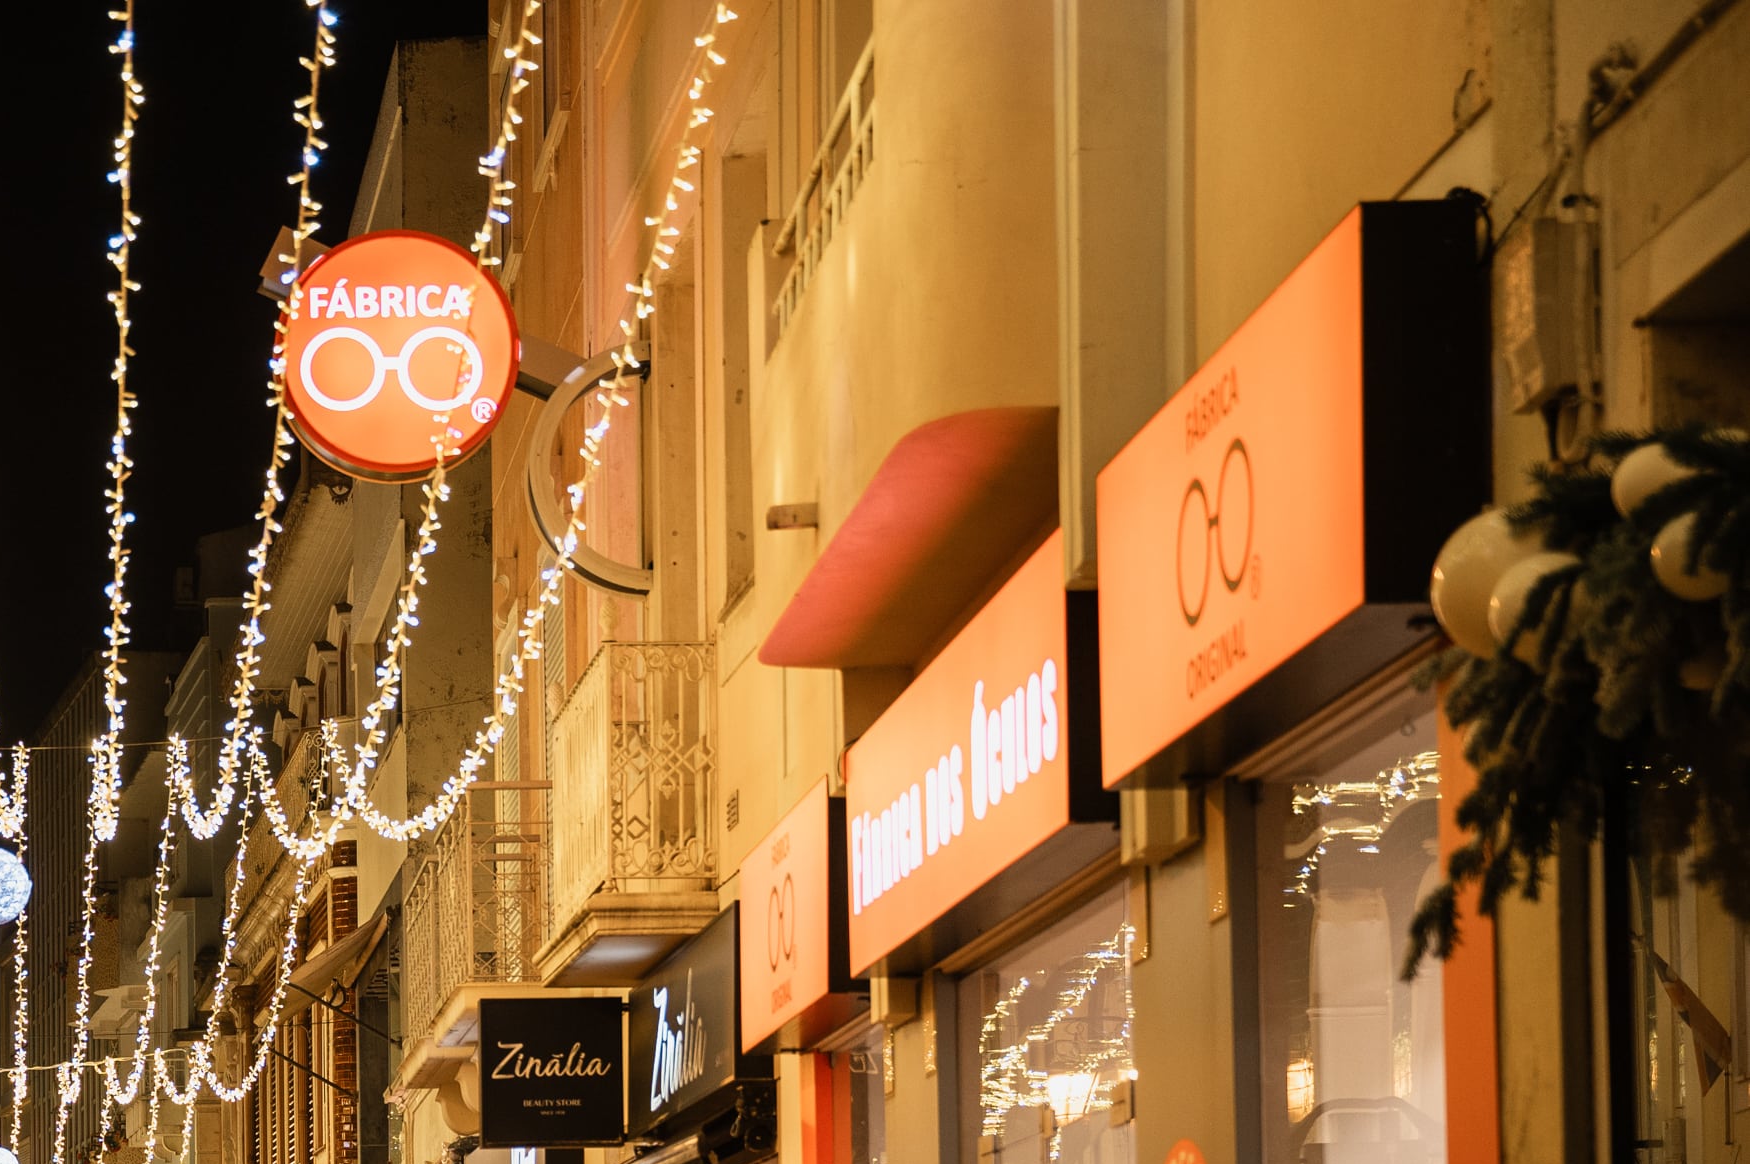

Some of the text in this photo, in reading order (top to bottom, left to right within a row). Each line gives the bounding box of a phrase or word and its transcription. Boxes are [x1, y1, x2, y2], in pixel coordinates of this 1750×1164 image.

[308, 279, 471, 319] FÁBRICA
[1186, 366, 1239, 455] FÁBRICA
[1186, 618, 1247, 700] ORIGINAL
[523, 1099, 582, 1107] BEAUTY STORE
